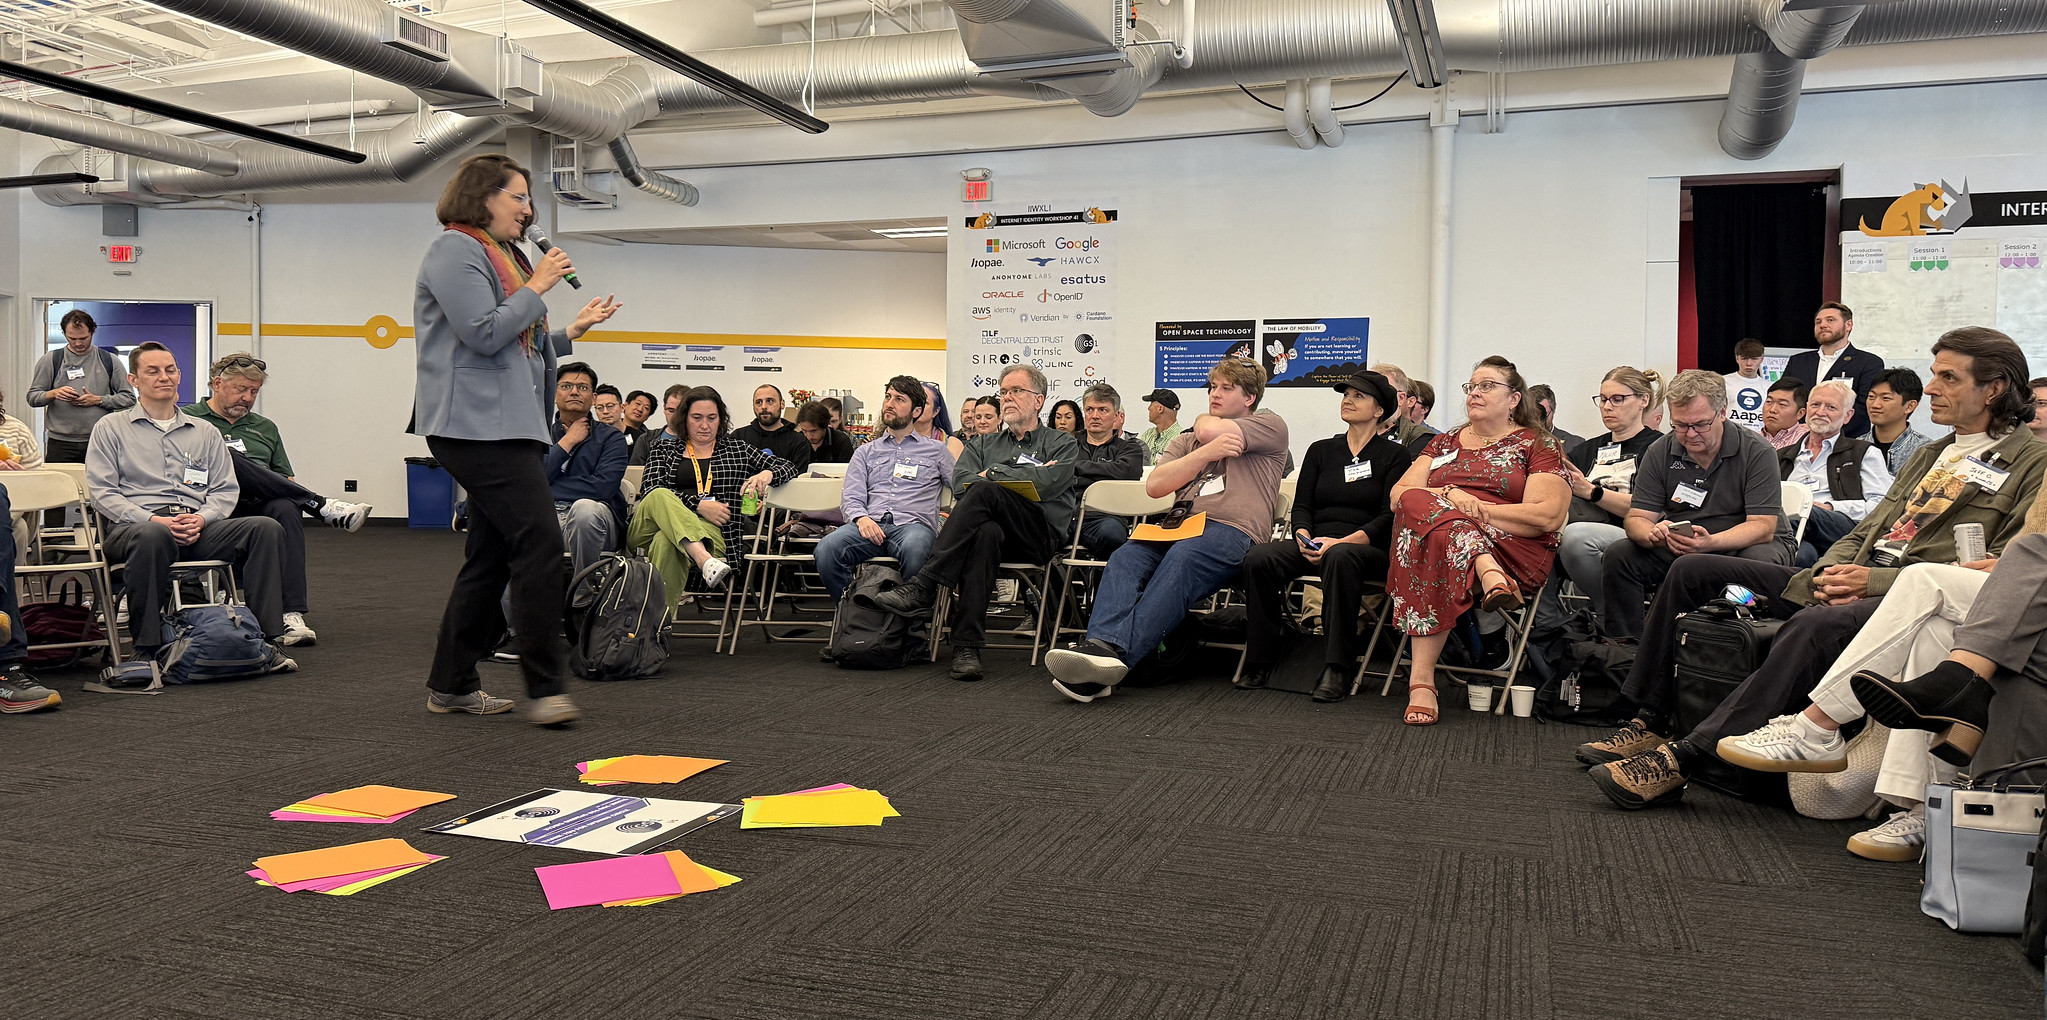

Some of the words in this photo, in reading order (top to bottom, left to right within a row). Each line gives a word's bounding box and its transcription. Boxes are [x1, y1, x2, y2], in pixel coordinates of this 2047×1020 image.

[966, 182, 988, 200] EXIT
[2001, 202, 2047, 217] INTER
[1002, 239, 1046, 250] Microsoft
[1055, 236, 1100, 252] Google
[110, 245, 132, 262] EXIT
[1060, 256, 1100, 265] HAWCX
[1061, 274, 1106, 285] esatus
[1053, 292, 1083, 302] OpenID
[972, 306, 991, 315] aws
[994, 306, 1017, 314] identity
[1030, 314, 1060, 322] Veridian
[981, 336, 1039, 344] DECENTRALIZED
[1033, 347, 1062, 356] trinsic
[1730, 410, 1763, 423] Aape
